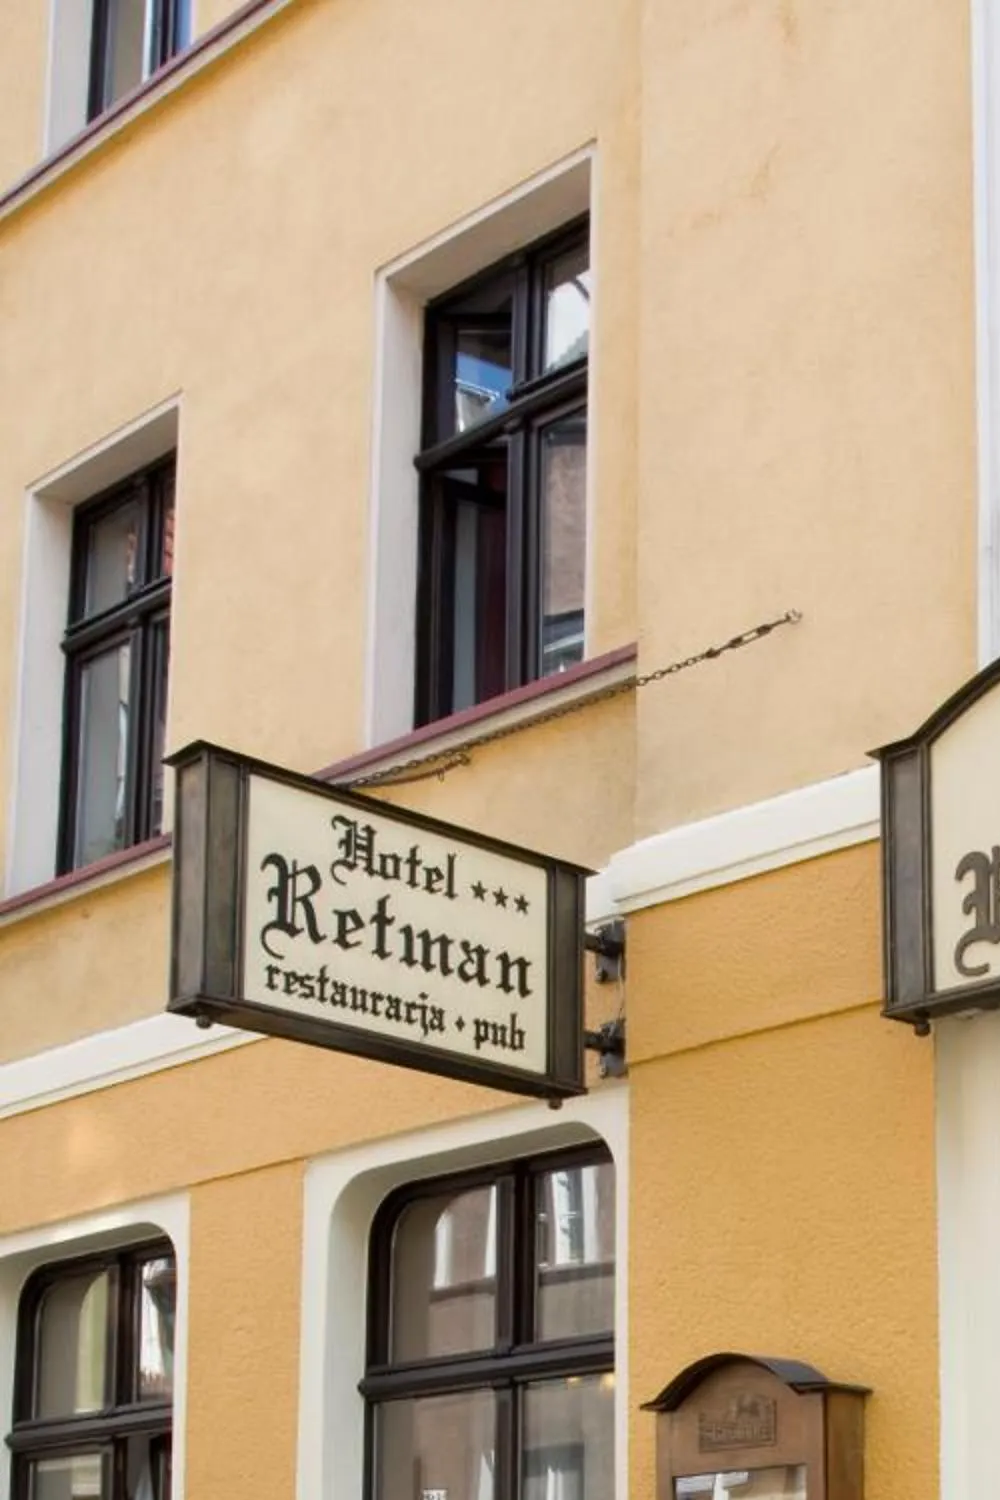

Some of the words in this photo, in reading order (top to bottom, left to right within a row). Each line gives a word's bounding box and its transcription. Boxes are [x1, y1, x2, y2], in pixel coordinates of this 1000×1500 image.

[331, 815, 457, 899] Hotel
[261, 853, 532, 998] Retman
[265, 964, 446, 1037] restauracja
[474, 1013, 526, 1052] pub
